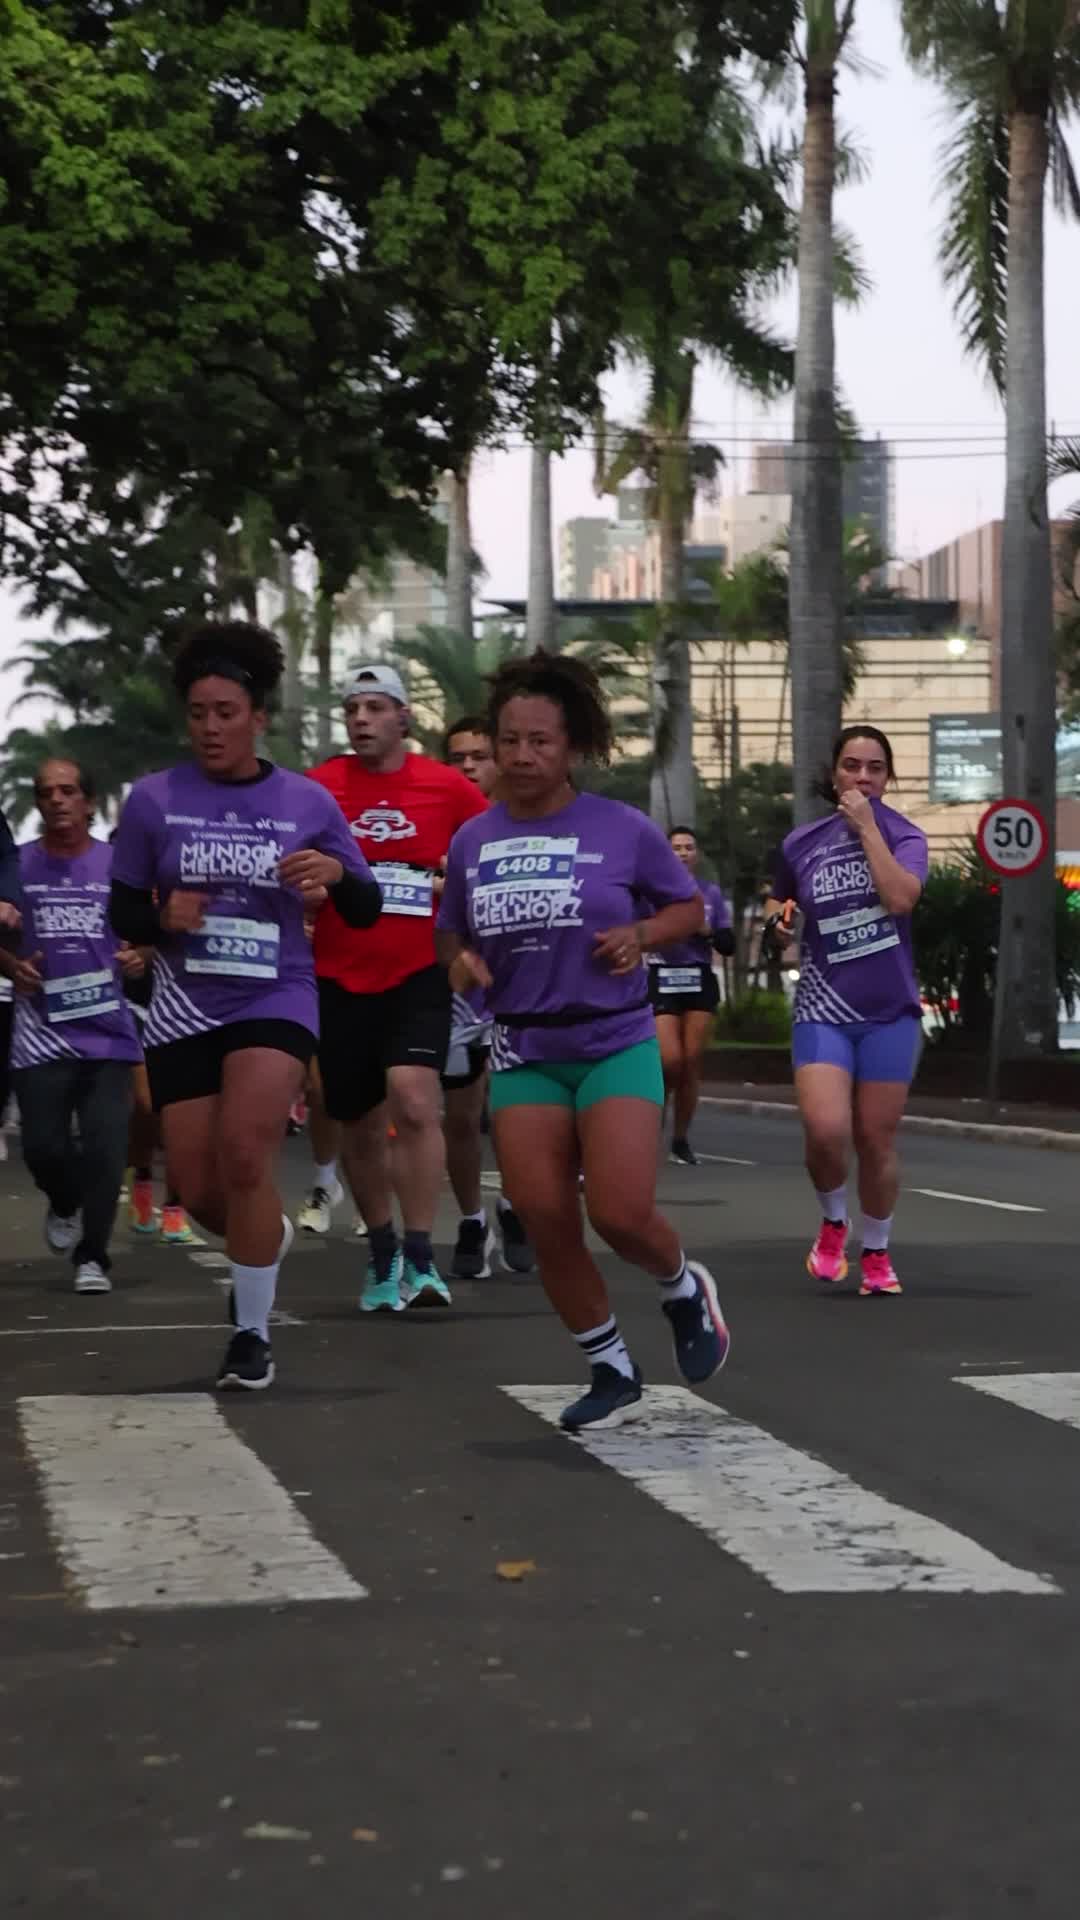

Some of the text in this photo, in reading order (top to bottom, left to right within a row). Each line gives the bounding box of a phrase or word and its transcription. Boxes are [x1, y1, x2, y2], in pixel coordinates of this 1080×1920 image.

[993, 817, 1033, 848] 50
[181, 842, 264, 860] MUNDO
[495, 856, 552, 876] 6408
[383, 884, 416, 900] 182
[813, 874, 867, 896] MELHO
[836, 923, 878, 946] 6309
[206, 936, 259, 957] 6220
